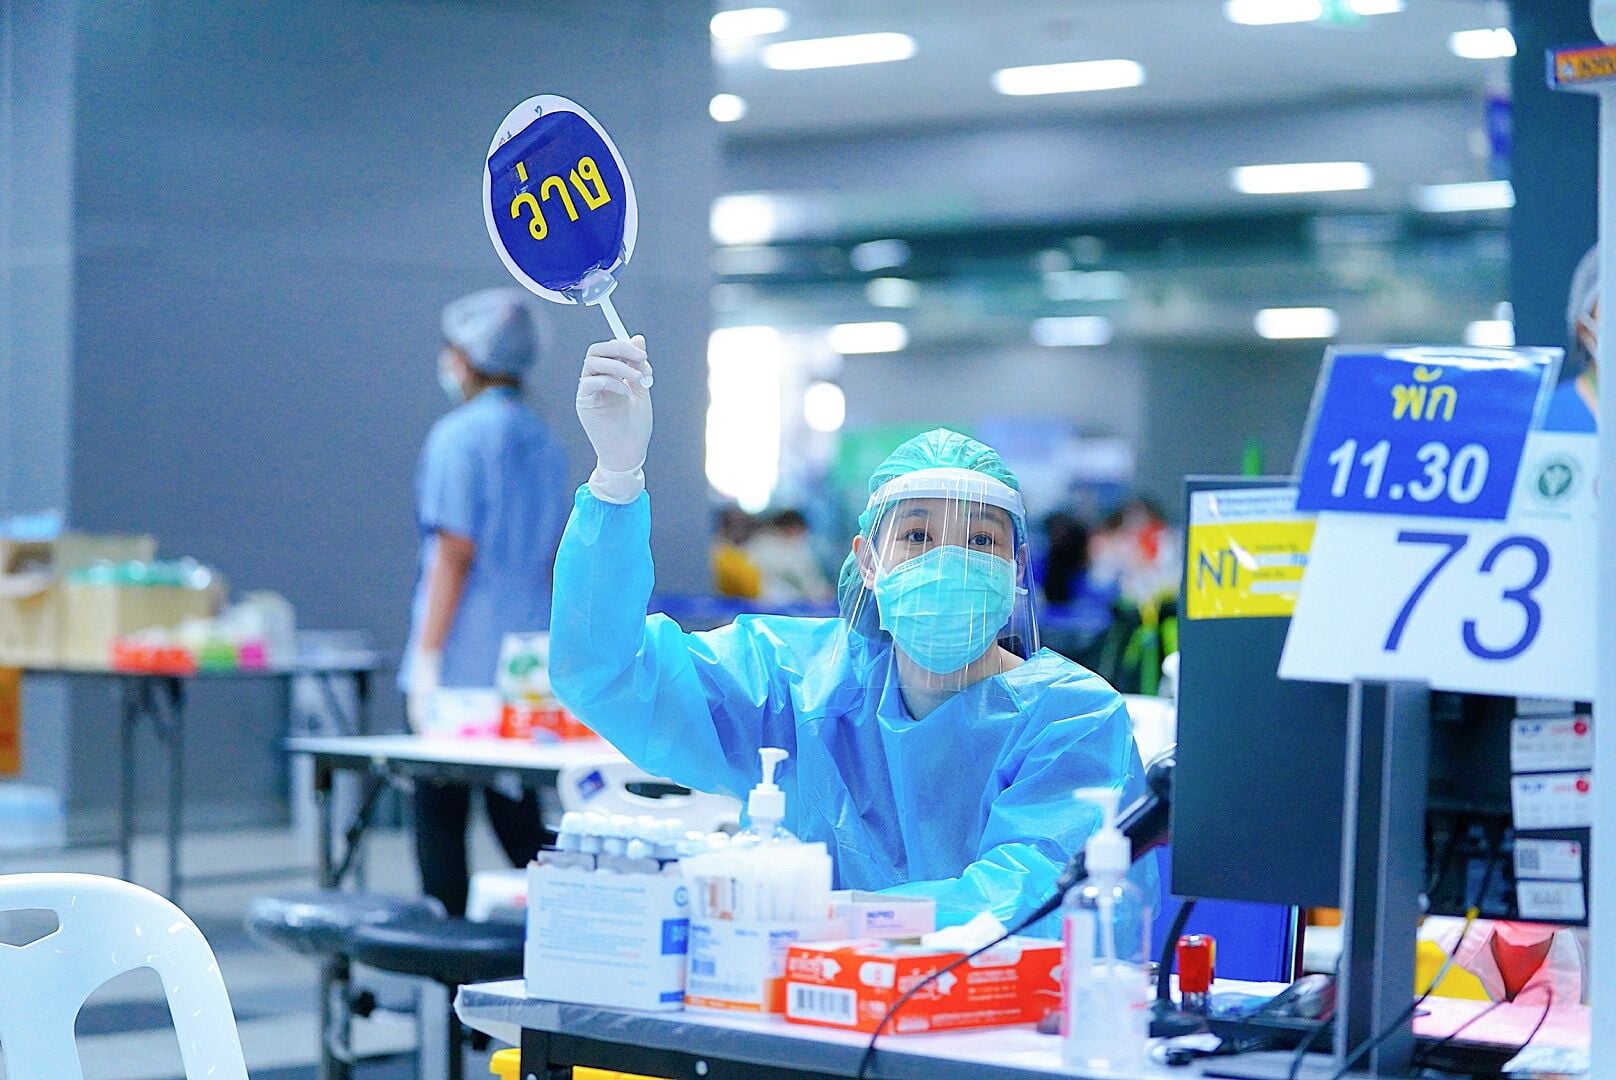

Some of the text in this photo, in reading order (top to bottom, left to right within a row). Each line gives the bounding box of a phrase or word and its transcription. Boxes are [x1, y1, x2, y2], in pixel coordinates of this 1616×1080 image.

[510, 156, 613, 241] ว่าง
[1391, 365, 1458, 422] พัก
[1327, 438, 1490, 504] 11.30
[1383, 530, 1552, 662] 73
